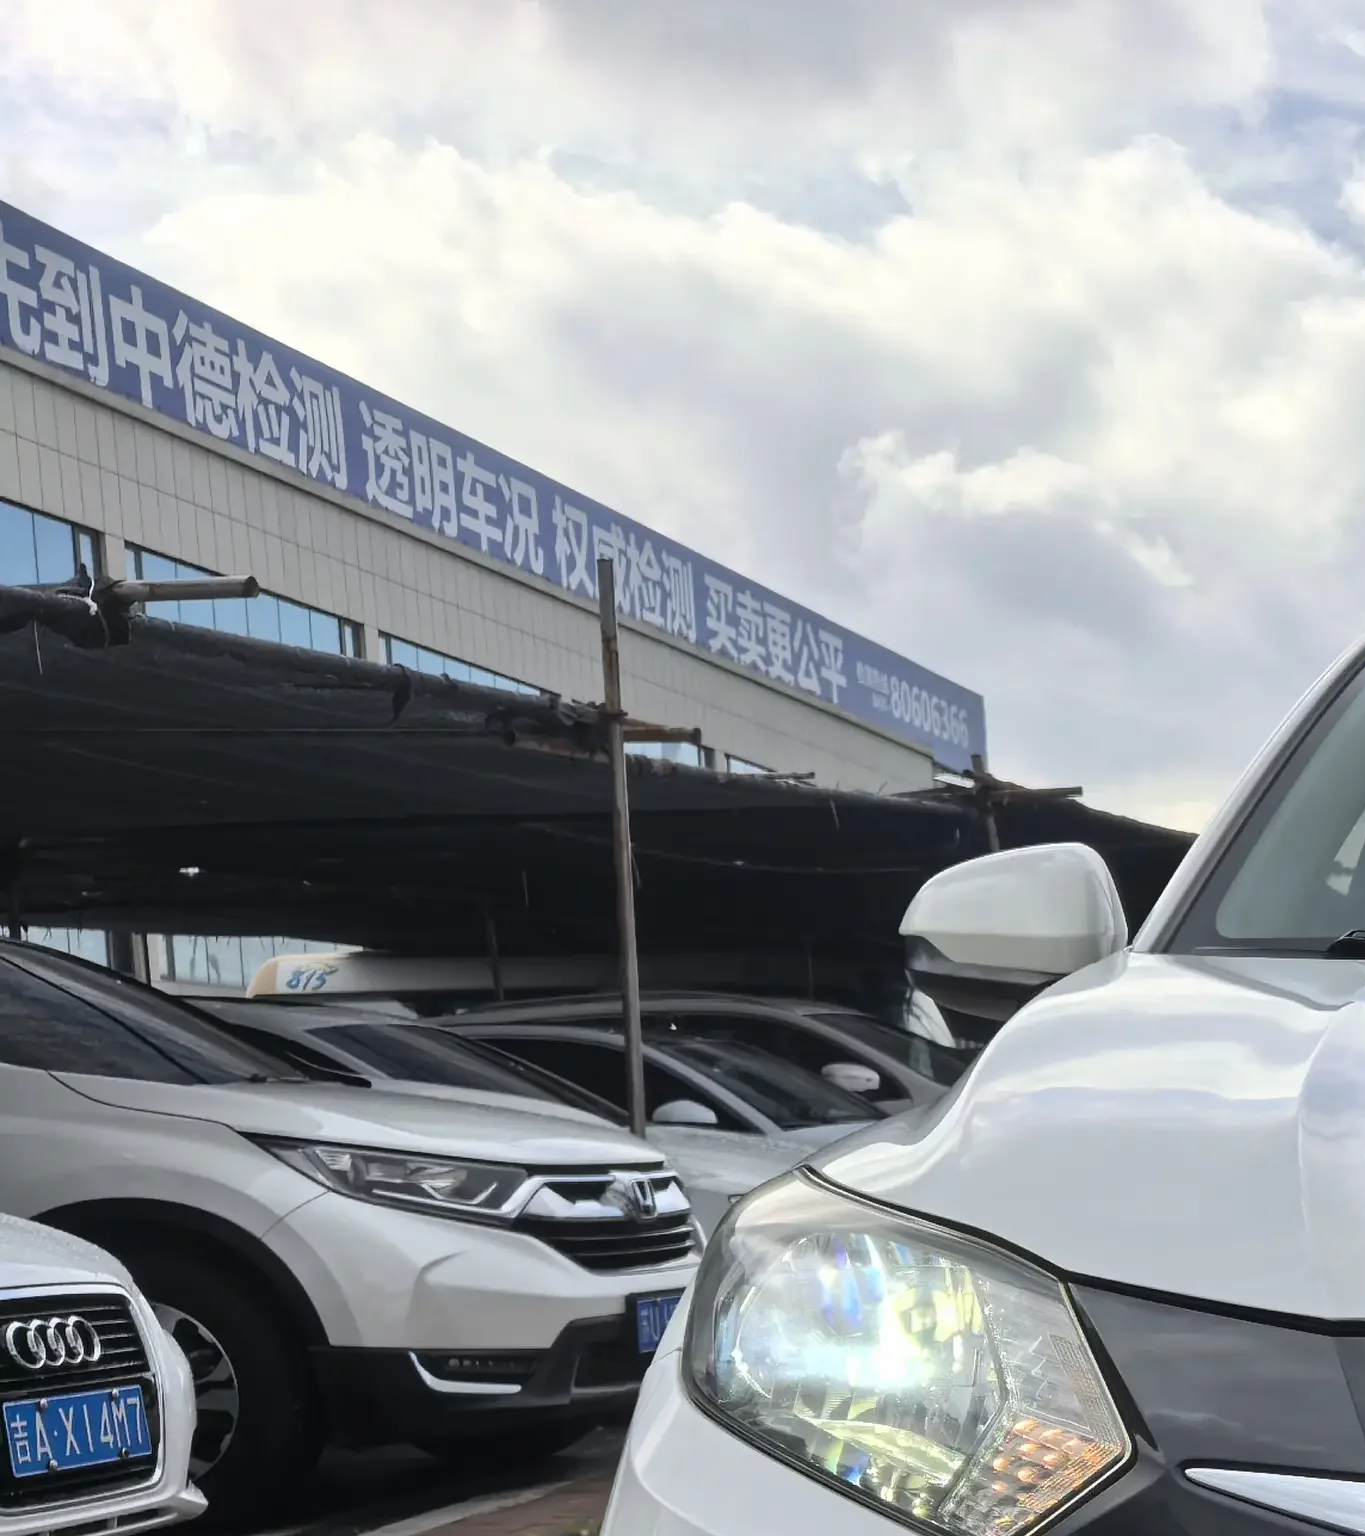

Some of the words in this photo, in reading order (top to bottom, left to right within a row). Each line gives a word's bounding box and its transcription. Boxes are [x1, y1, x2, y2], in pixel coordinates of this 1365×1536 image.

[359, 400, 544, 575] 透明车况
[552, 494, 697, 644] 权威检测
[704, 573, 847, 704] 买卖更公平
[890, 676, 969, 749] 80606366
